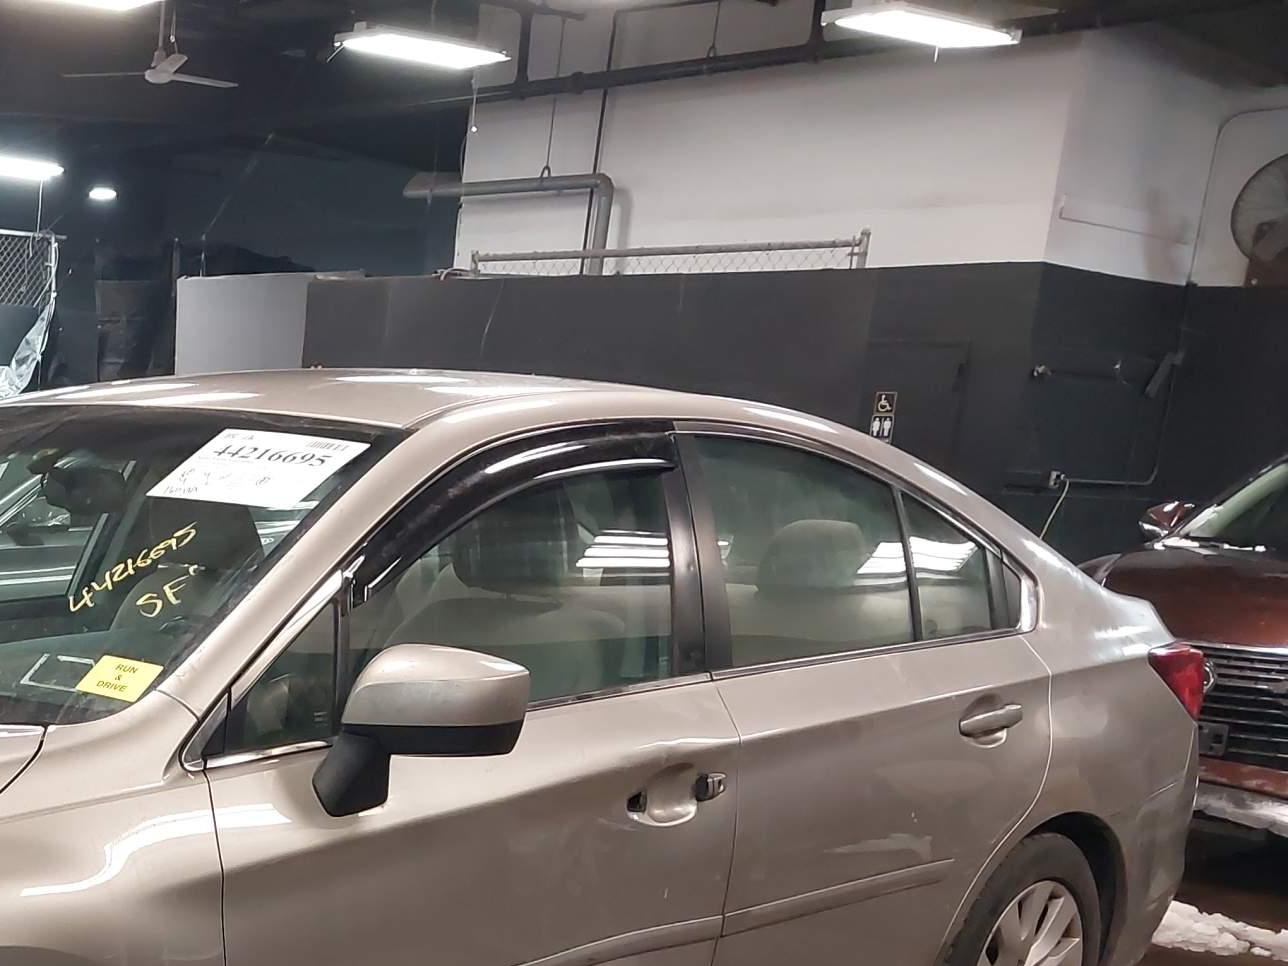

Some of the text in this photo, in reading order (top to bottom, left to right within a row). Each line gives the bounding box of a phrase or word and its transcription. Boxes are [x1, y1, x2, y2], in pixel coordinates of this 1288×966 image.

[213, 445, 333, 467] 44216695
[69, 521, 199, 612] 44216695
[115, 663, 139, 674] RUN
[96, 680, 128, 692] DRIVE
